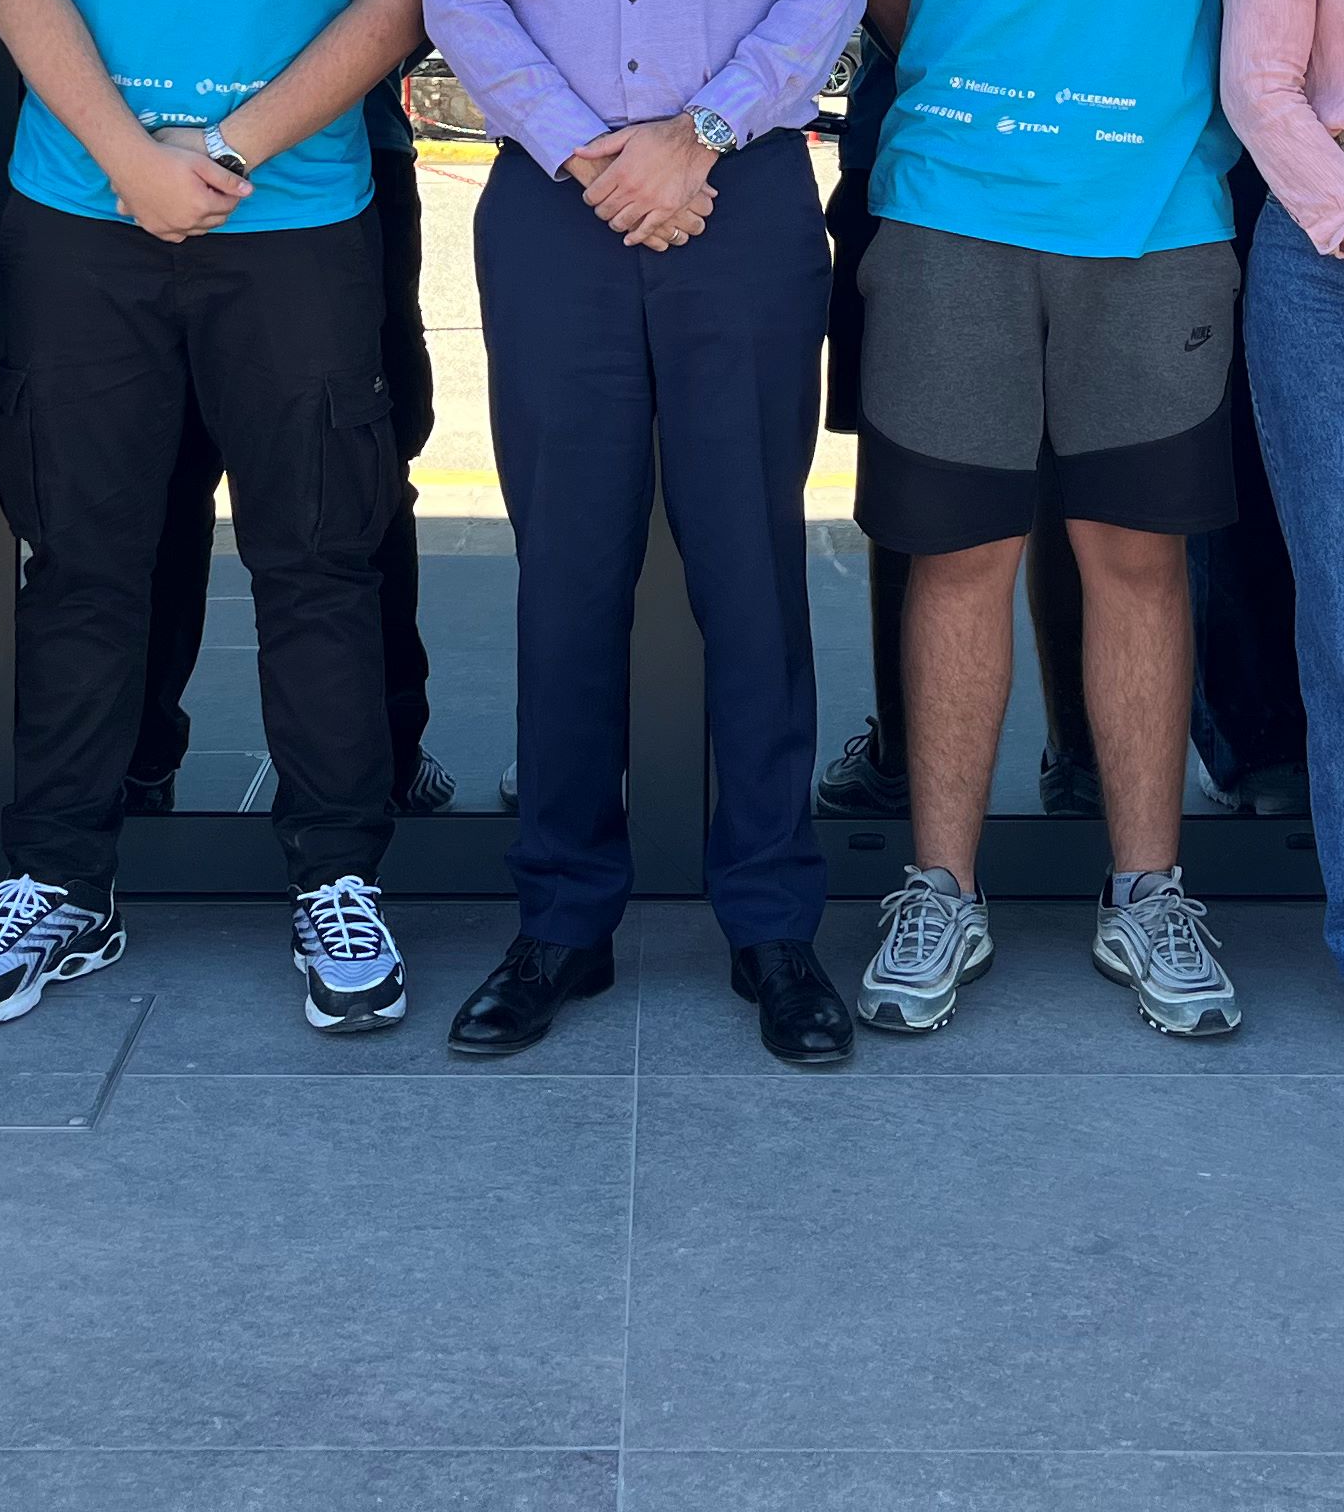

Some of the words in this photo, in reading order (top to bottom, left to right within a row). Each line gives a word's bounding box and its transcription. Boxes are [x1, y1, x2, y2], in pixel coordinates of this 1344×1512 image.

[1072, 92, 1136, 106] KLEEMANN
[161, 114, 207, 123] TITAN
[915, 104, 972, 123] SAMSUNG
[1019, 122, 1059, 133] TITAN
[1190, 325, 1213, 340] NIKE
